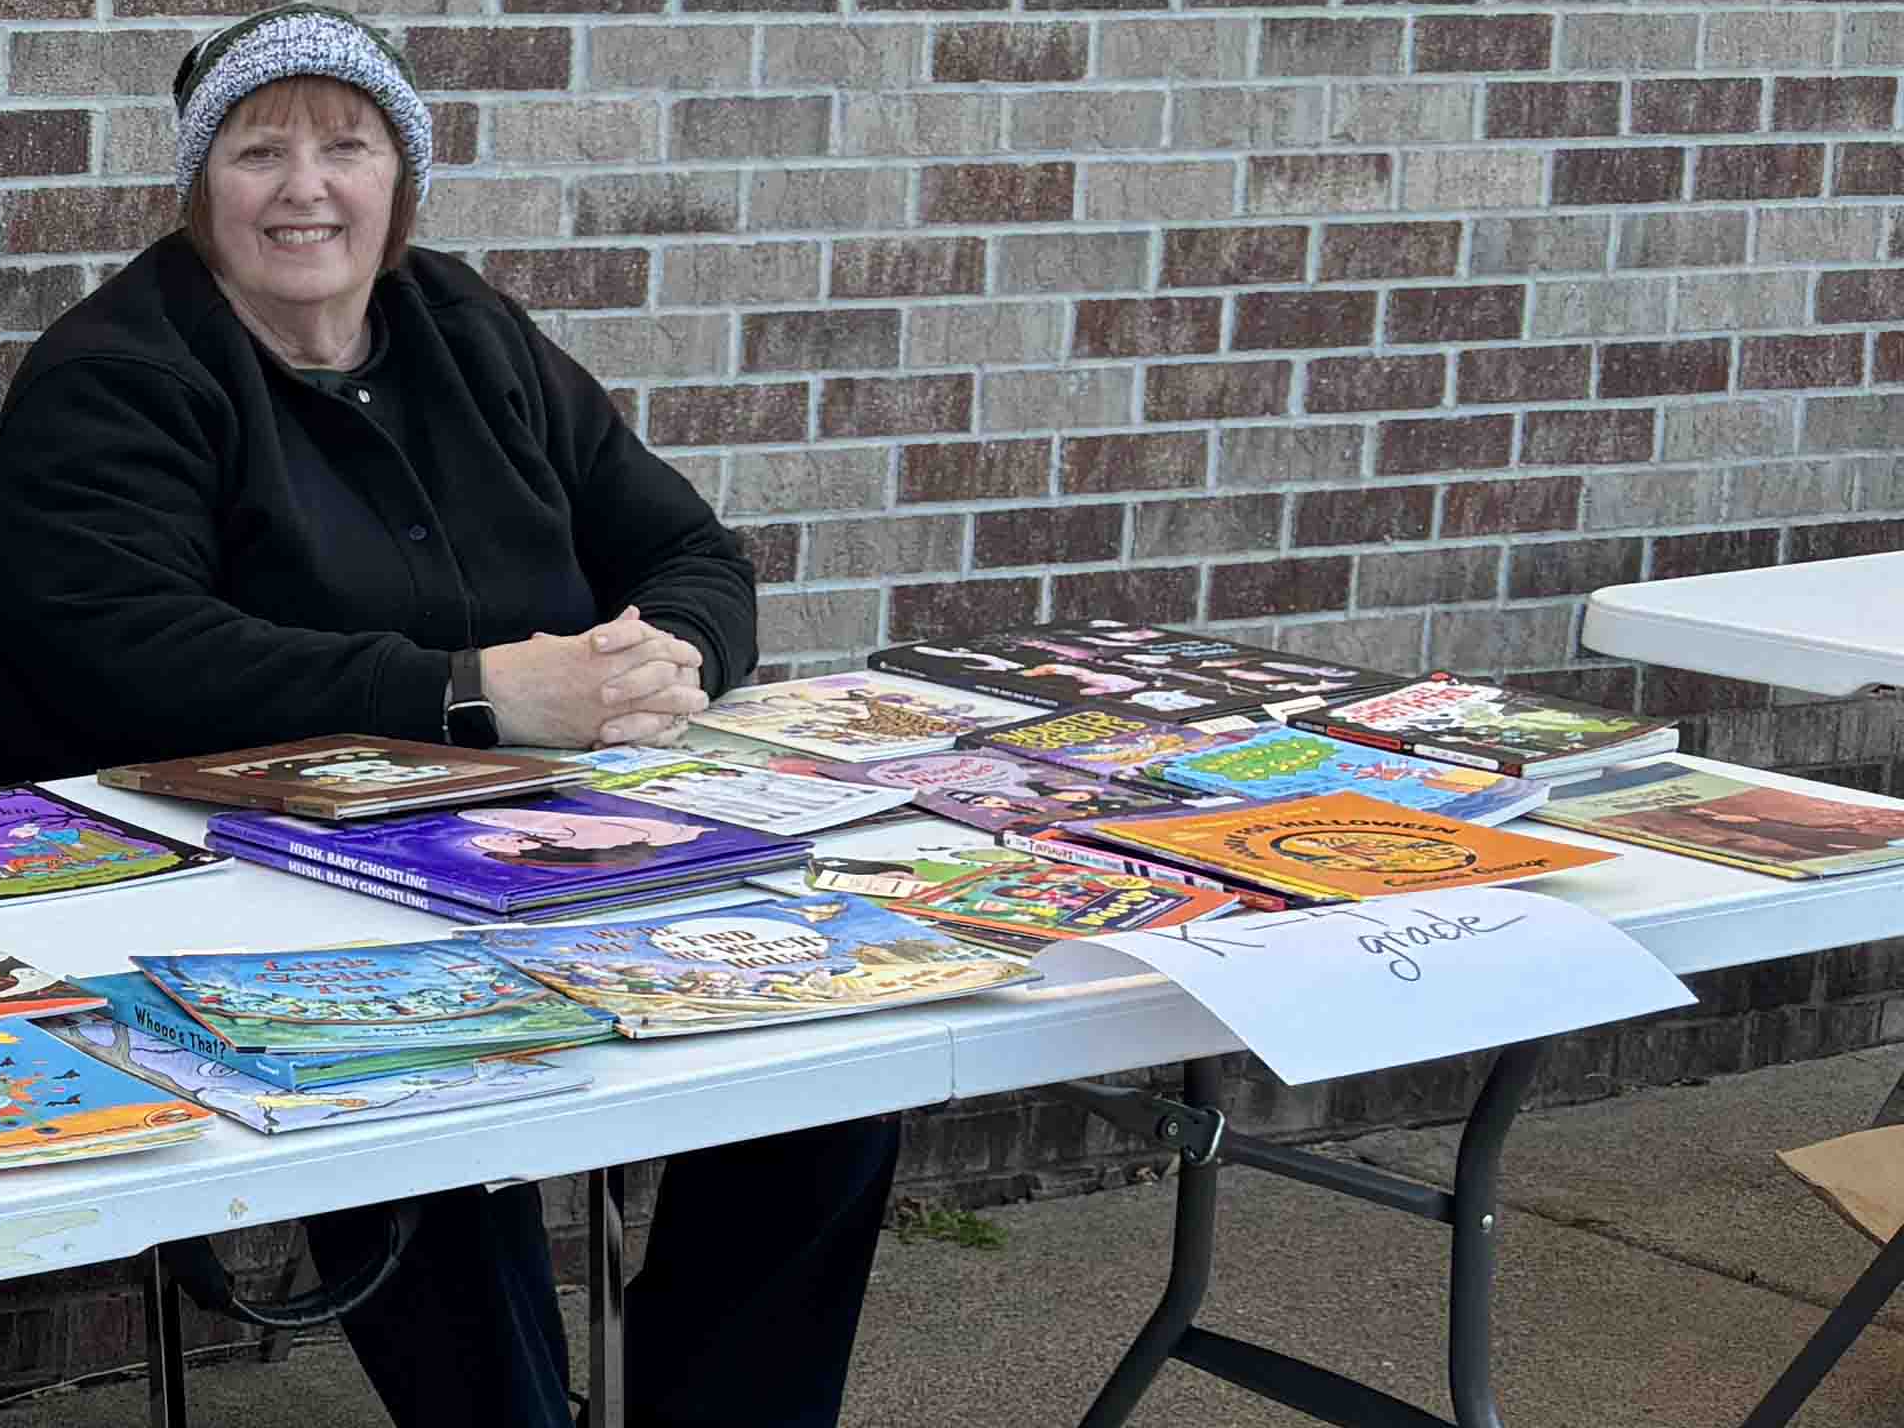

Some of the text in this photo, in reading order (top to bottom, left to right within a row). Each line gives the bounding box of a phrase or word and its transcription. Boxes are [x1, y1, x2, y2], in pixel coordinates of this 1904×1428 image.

[1279, 817, 1462, 835] HALLOWEEN
[325, 870, 359, 892] BABY
[359, 879, 431, 911] GHOSTLING
[326, 850, 359, 873] BABY
[359, 861, 429, 891] GHOSTLING
[1356, 908, 1528, 983] grade
